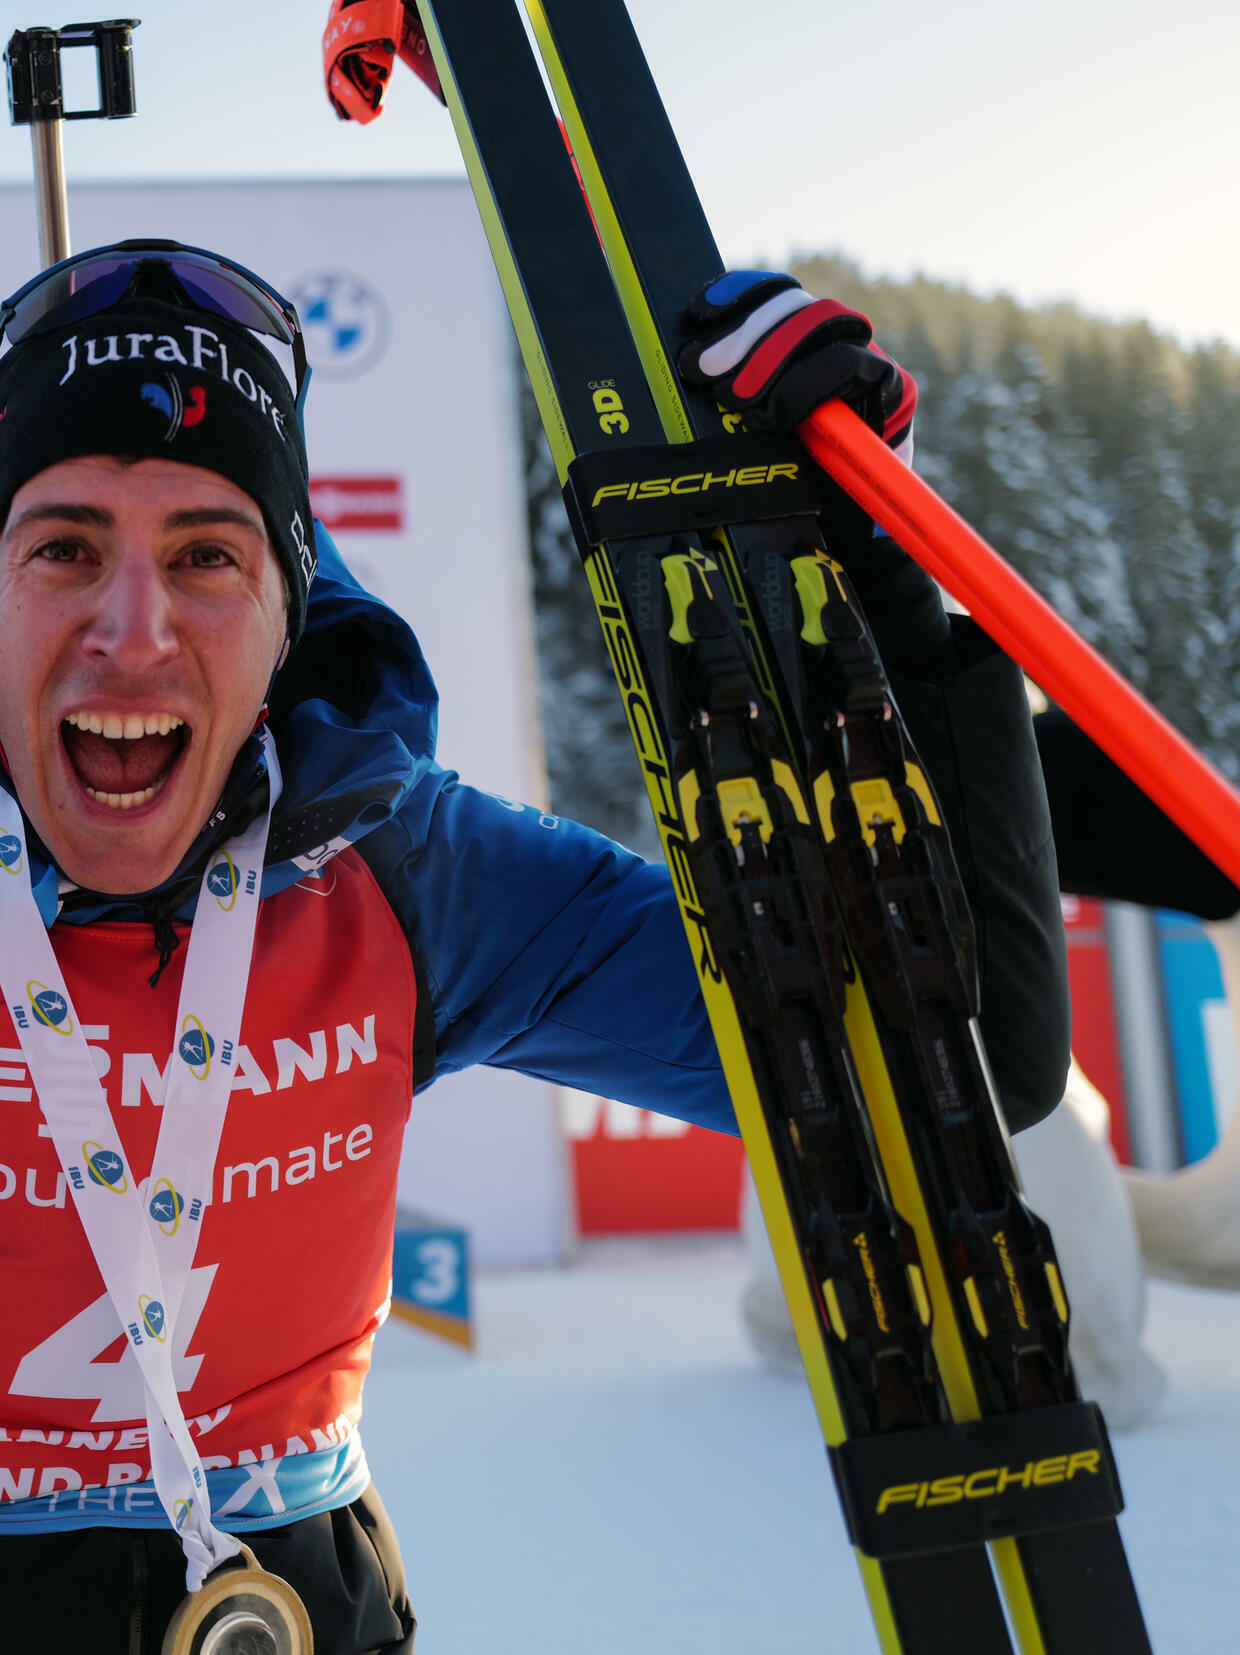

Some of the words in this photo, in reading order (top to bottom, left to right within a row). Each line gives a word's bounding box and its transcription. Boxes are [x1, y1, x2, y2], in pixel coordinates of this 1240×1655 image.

[587, 378, 617, 390] GLIDE
[655, 349, 673, 393] GLIDING
[592, 388, 630, 435] 3D
[592, 463, 799, 507] FISCHER
[245, 870, 257, 895] IBU
[12, 1005, 29, 1029] IBU
[220, 1040, 234, 1066] IBU
[68, 1166, 85, 1190] IBU
[188, 1198, 202, 1221] IBU
[413, 1240, 459, 1303] 3
[8, 1263, 219, 1423] 4
[128, 1322, 143, 1346] IBU
[875, 1448, 1101, 1515] FISCHER
